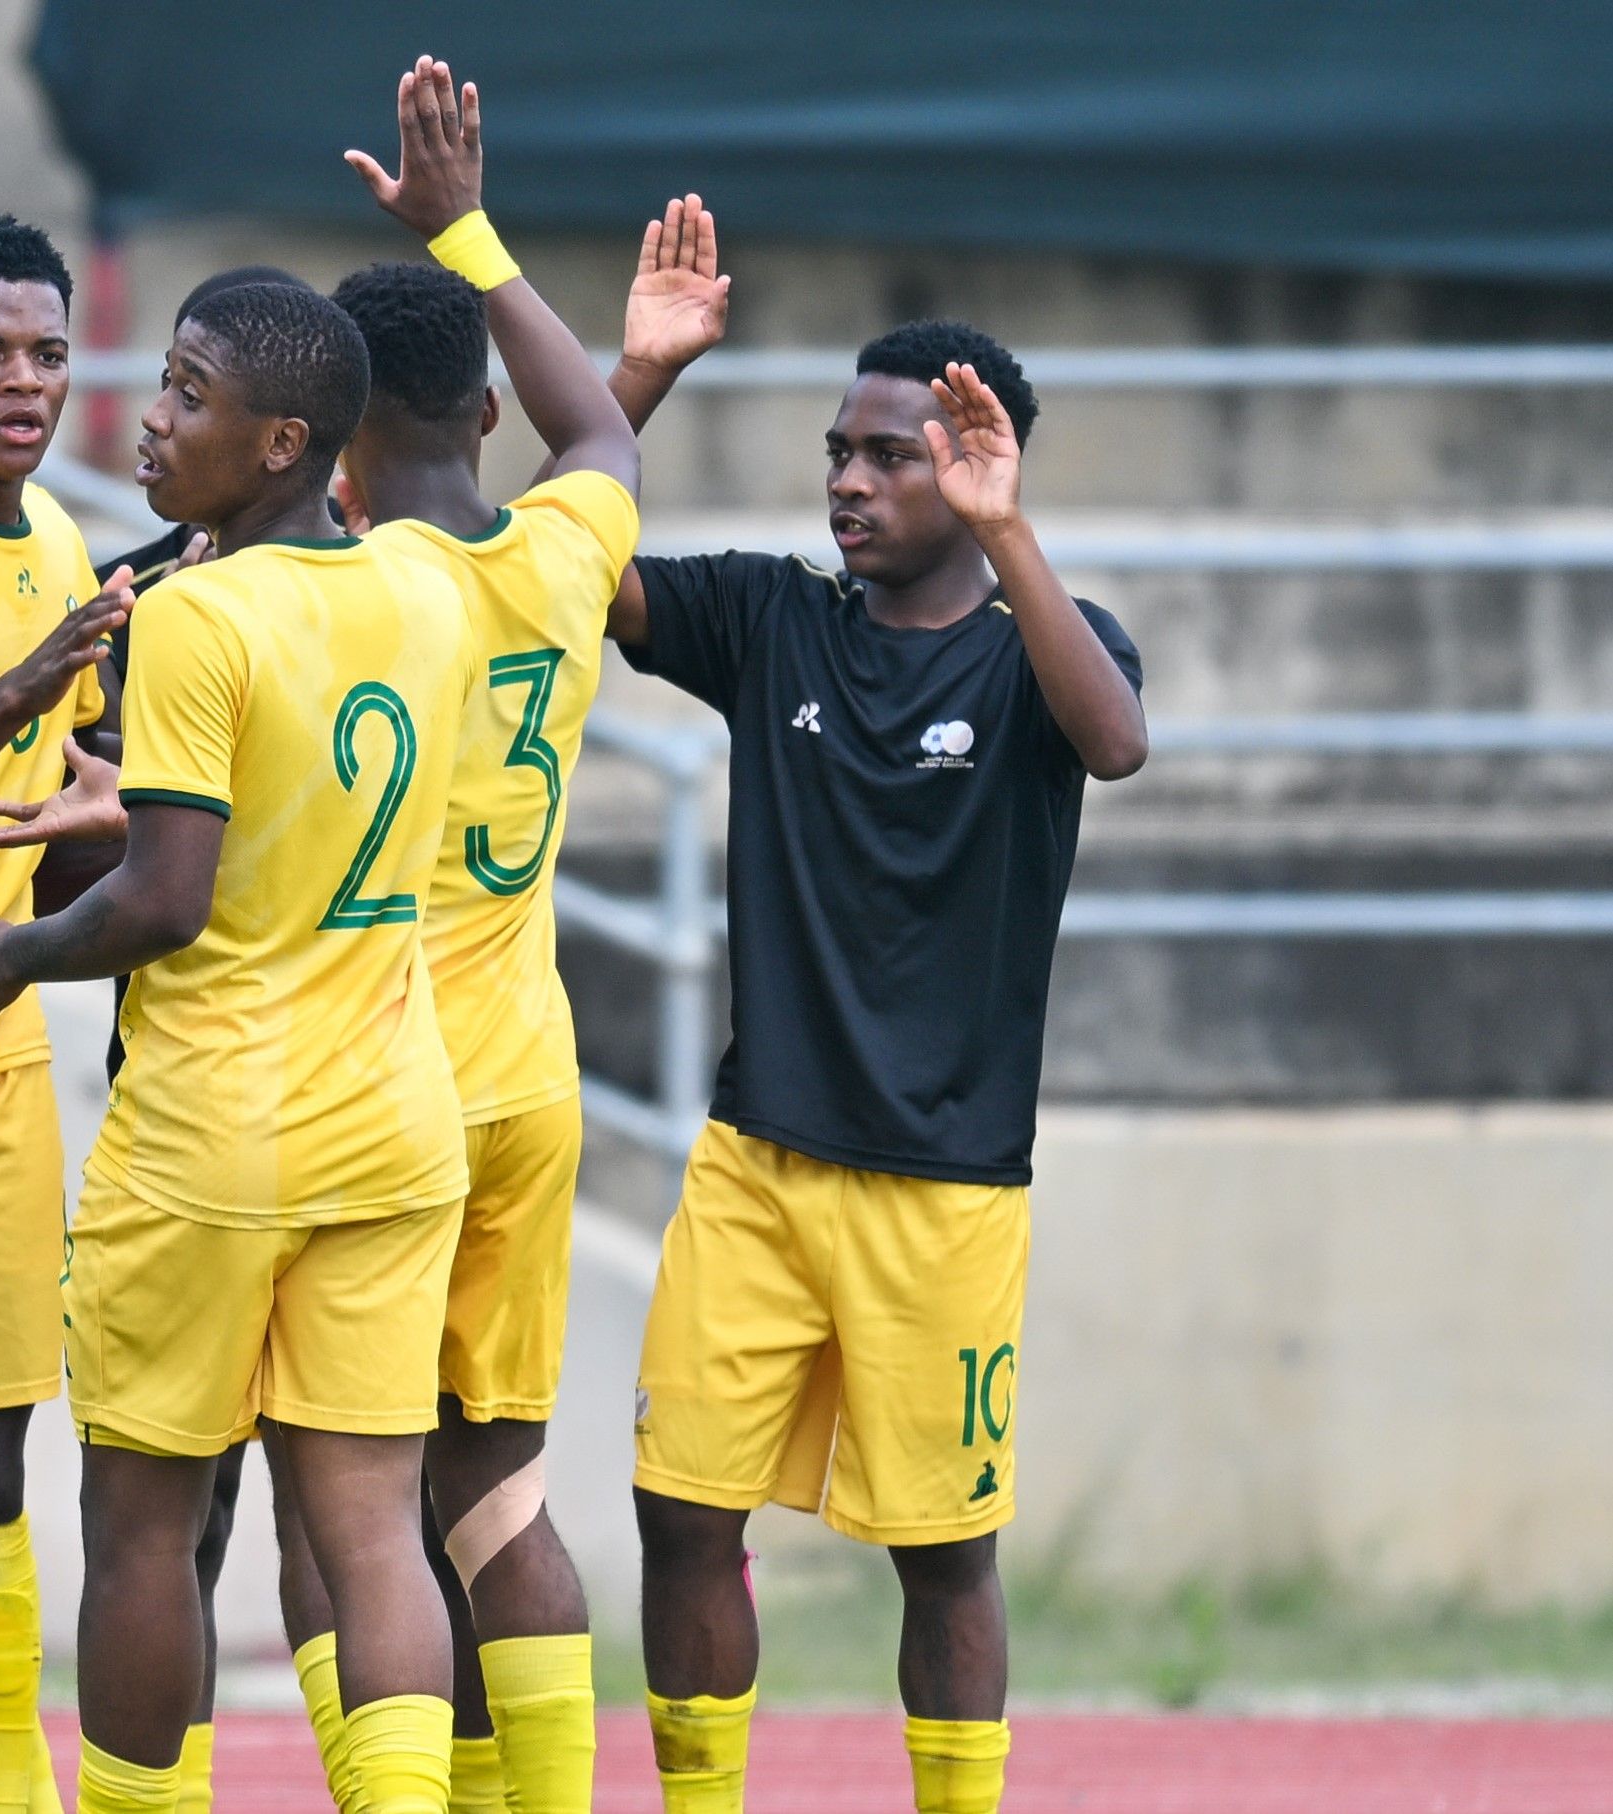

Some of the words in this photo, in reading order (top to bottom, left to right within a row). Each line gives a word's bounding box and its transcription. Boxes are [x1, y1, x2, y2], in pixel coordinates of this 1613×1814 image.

[315, 680, 418, 931] 2
[464, 648, 566, 896] 3
[958, 1342, 1015, 1447] 10
